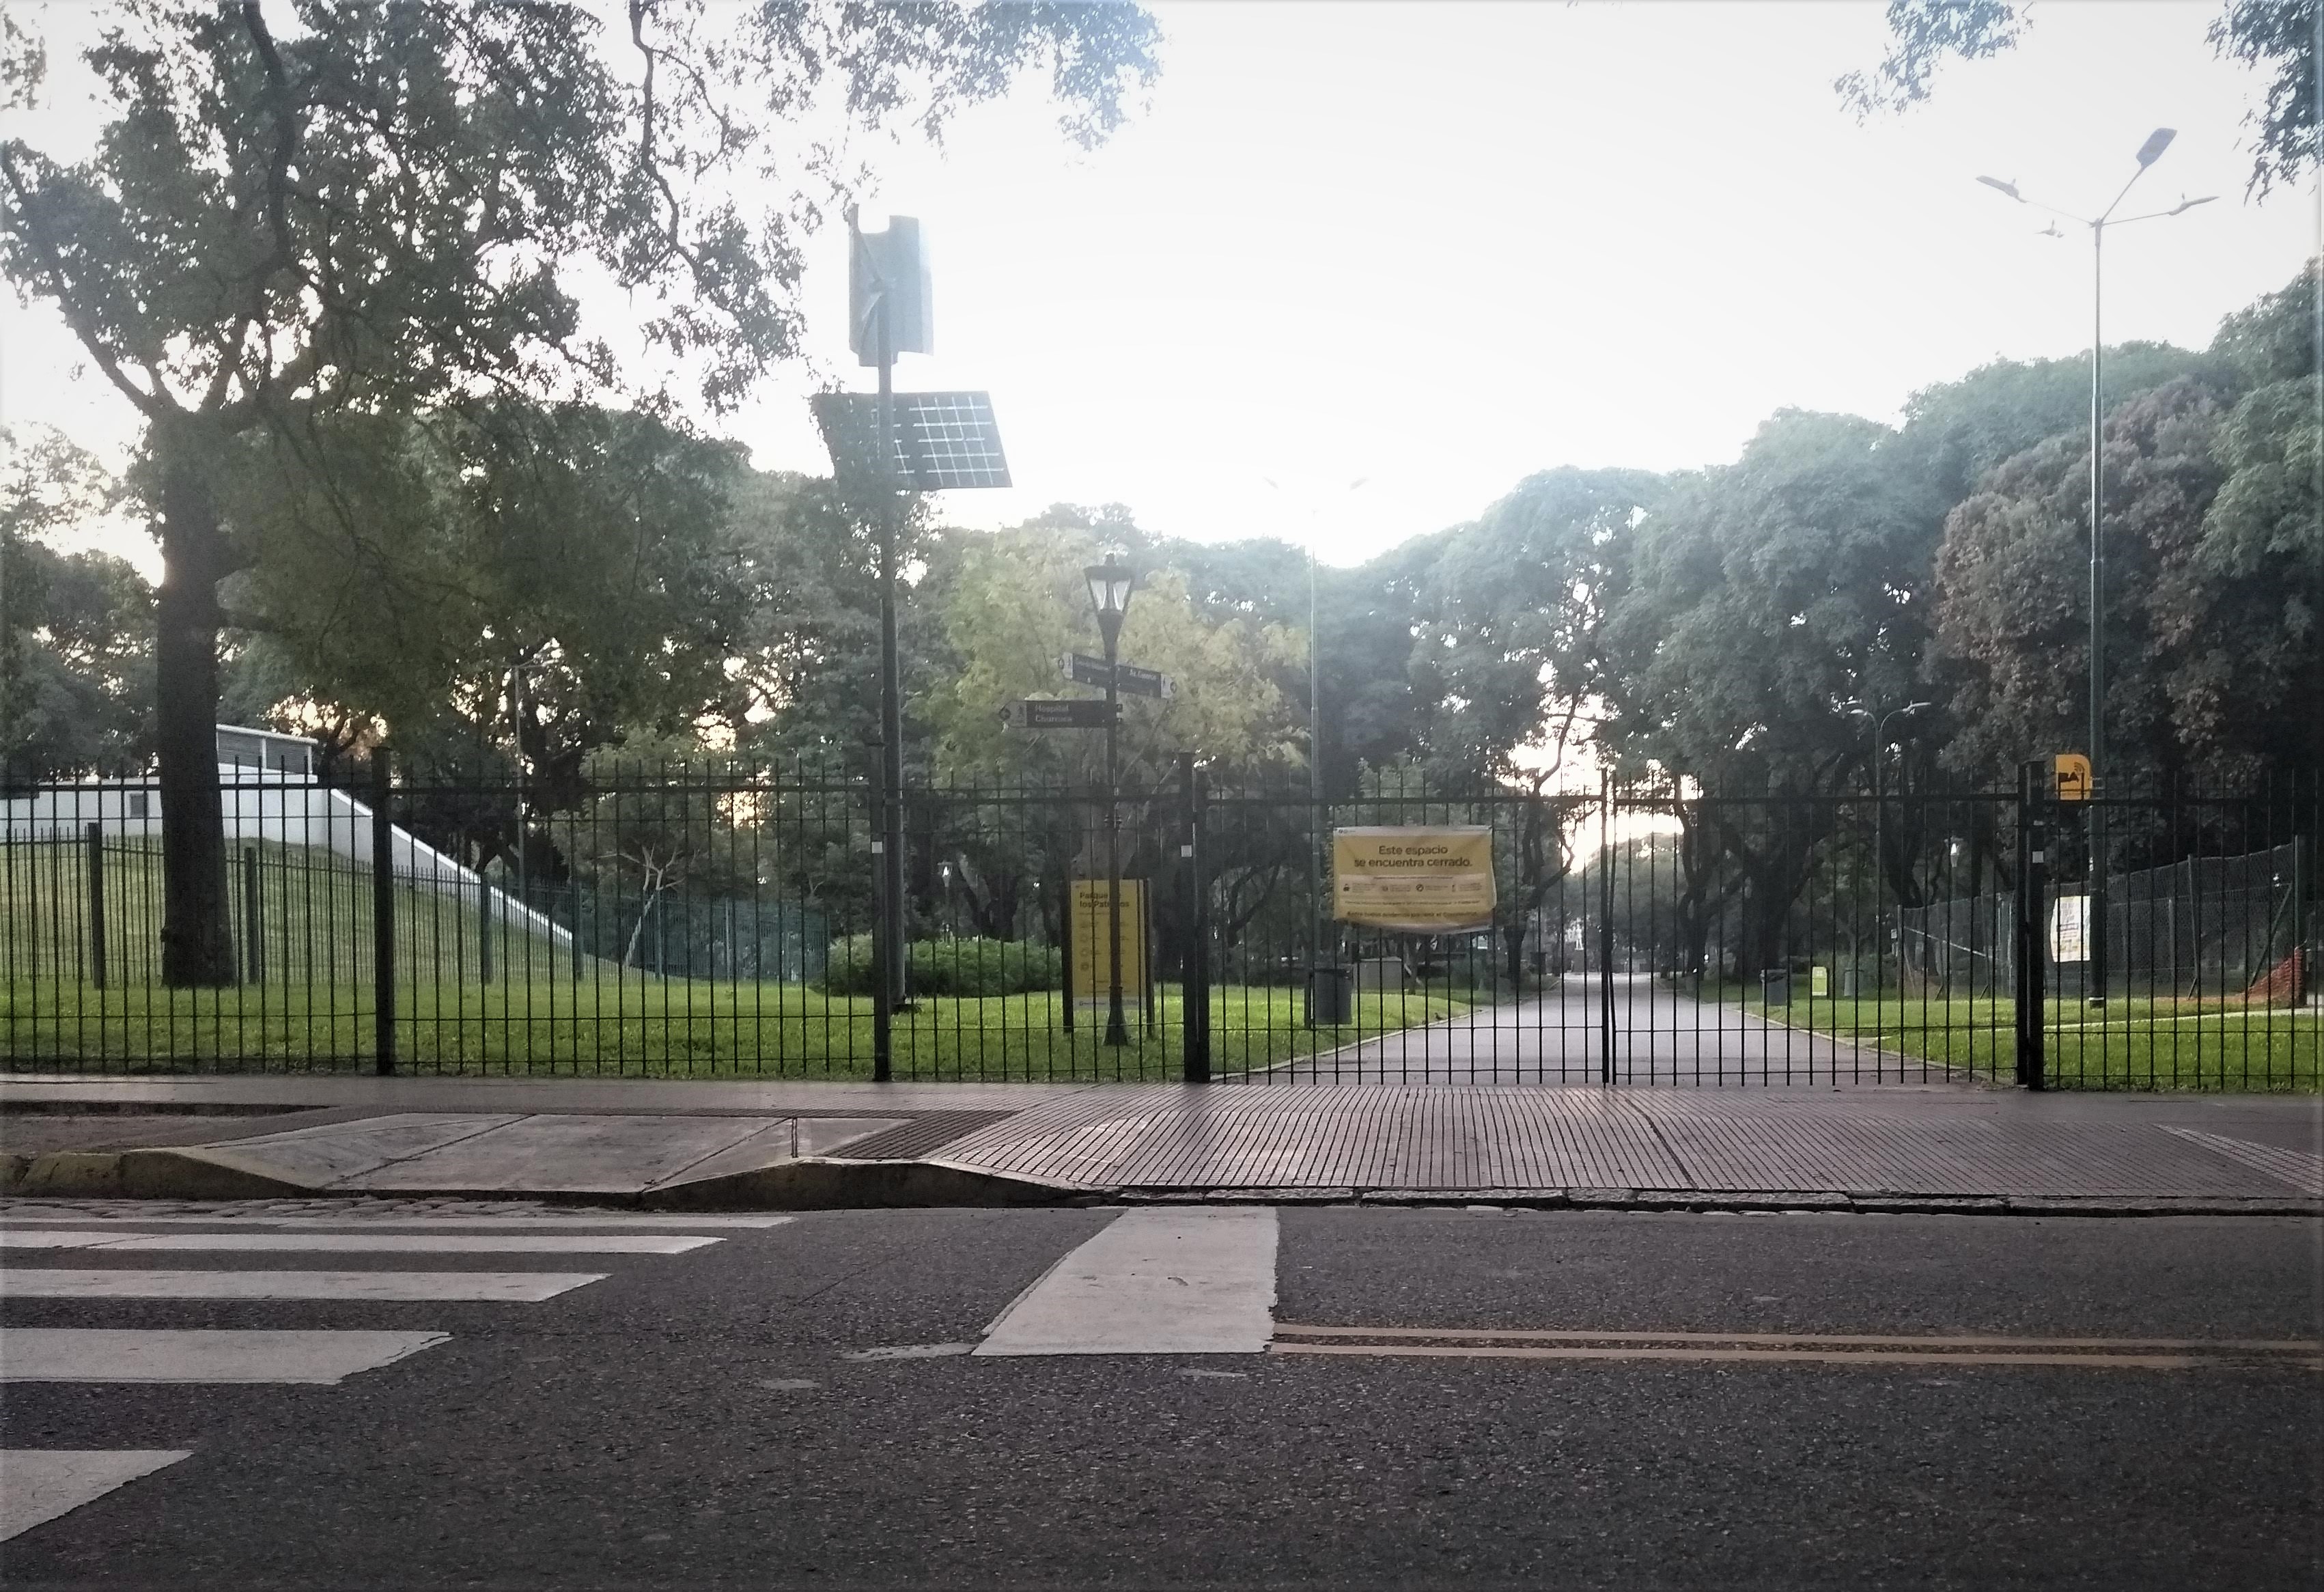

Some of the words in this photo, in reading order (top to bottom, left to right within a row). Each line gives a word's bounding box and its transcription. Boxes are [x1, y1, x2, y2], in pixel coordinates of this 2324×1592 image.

[1378, 846, 1403, 854] Este
[1405, 845, 1448, 856] espacio
[1354, 858, 1366, 867] se
[1369, 858, 1425, 867] encuentra
[1427, 857, 1473, 867] cerrado.
